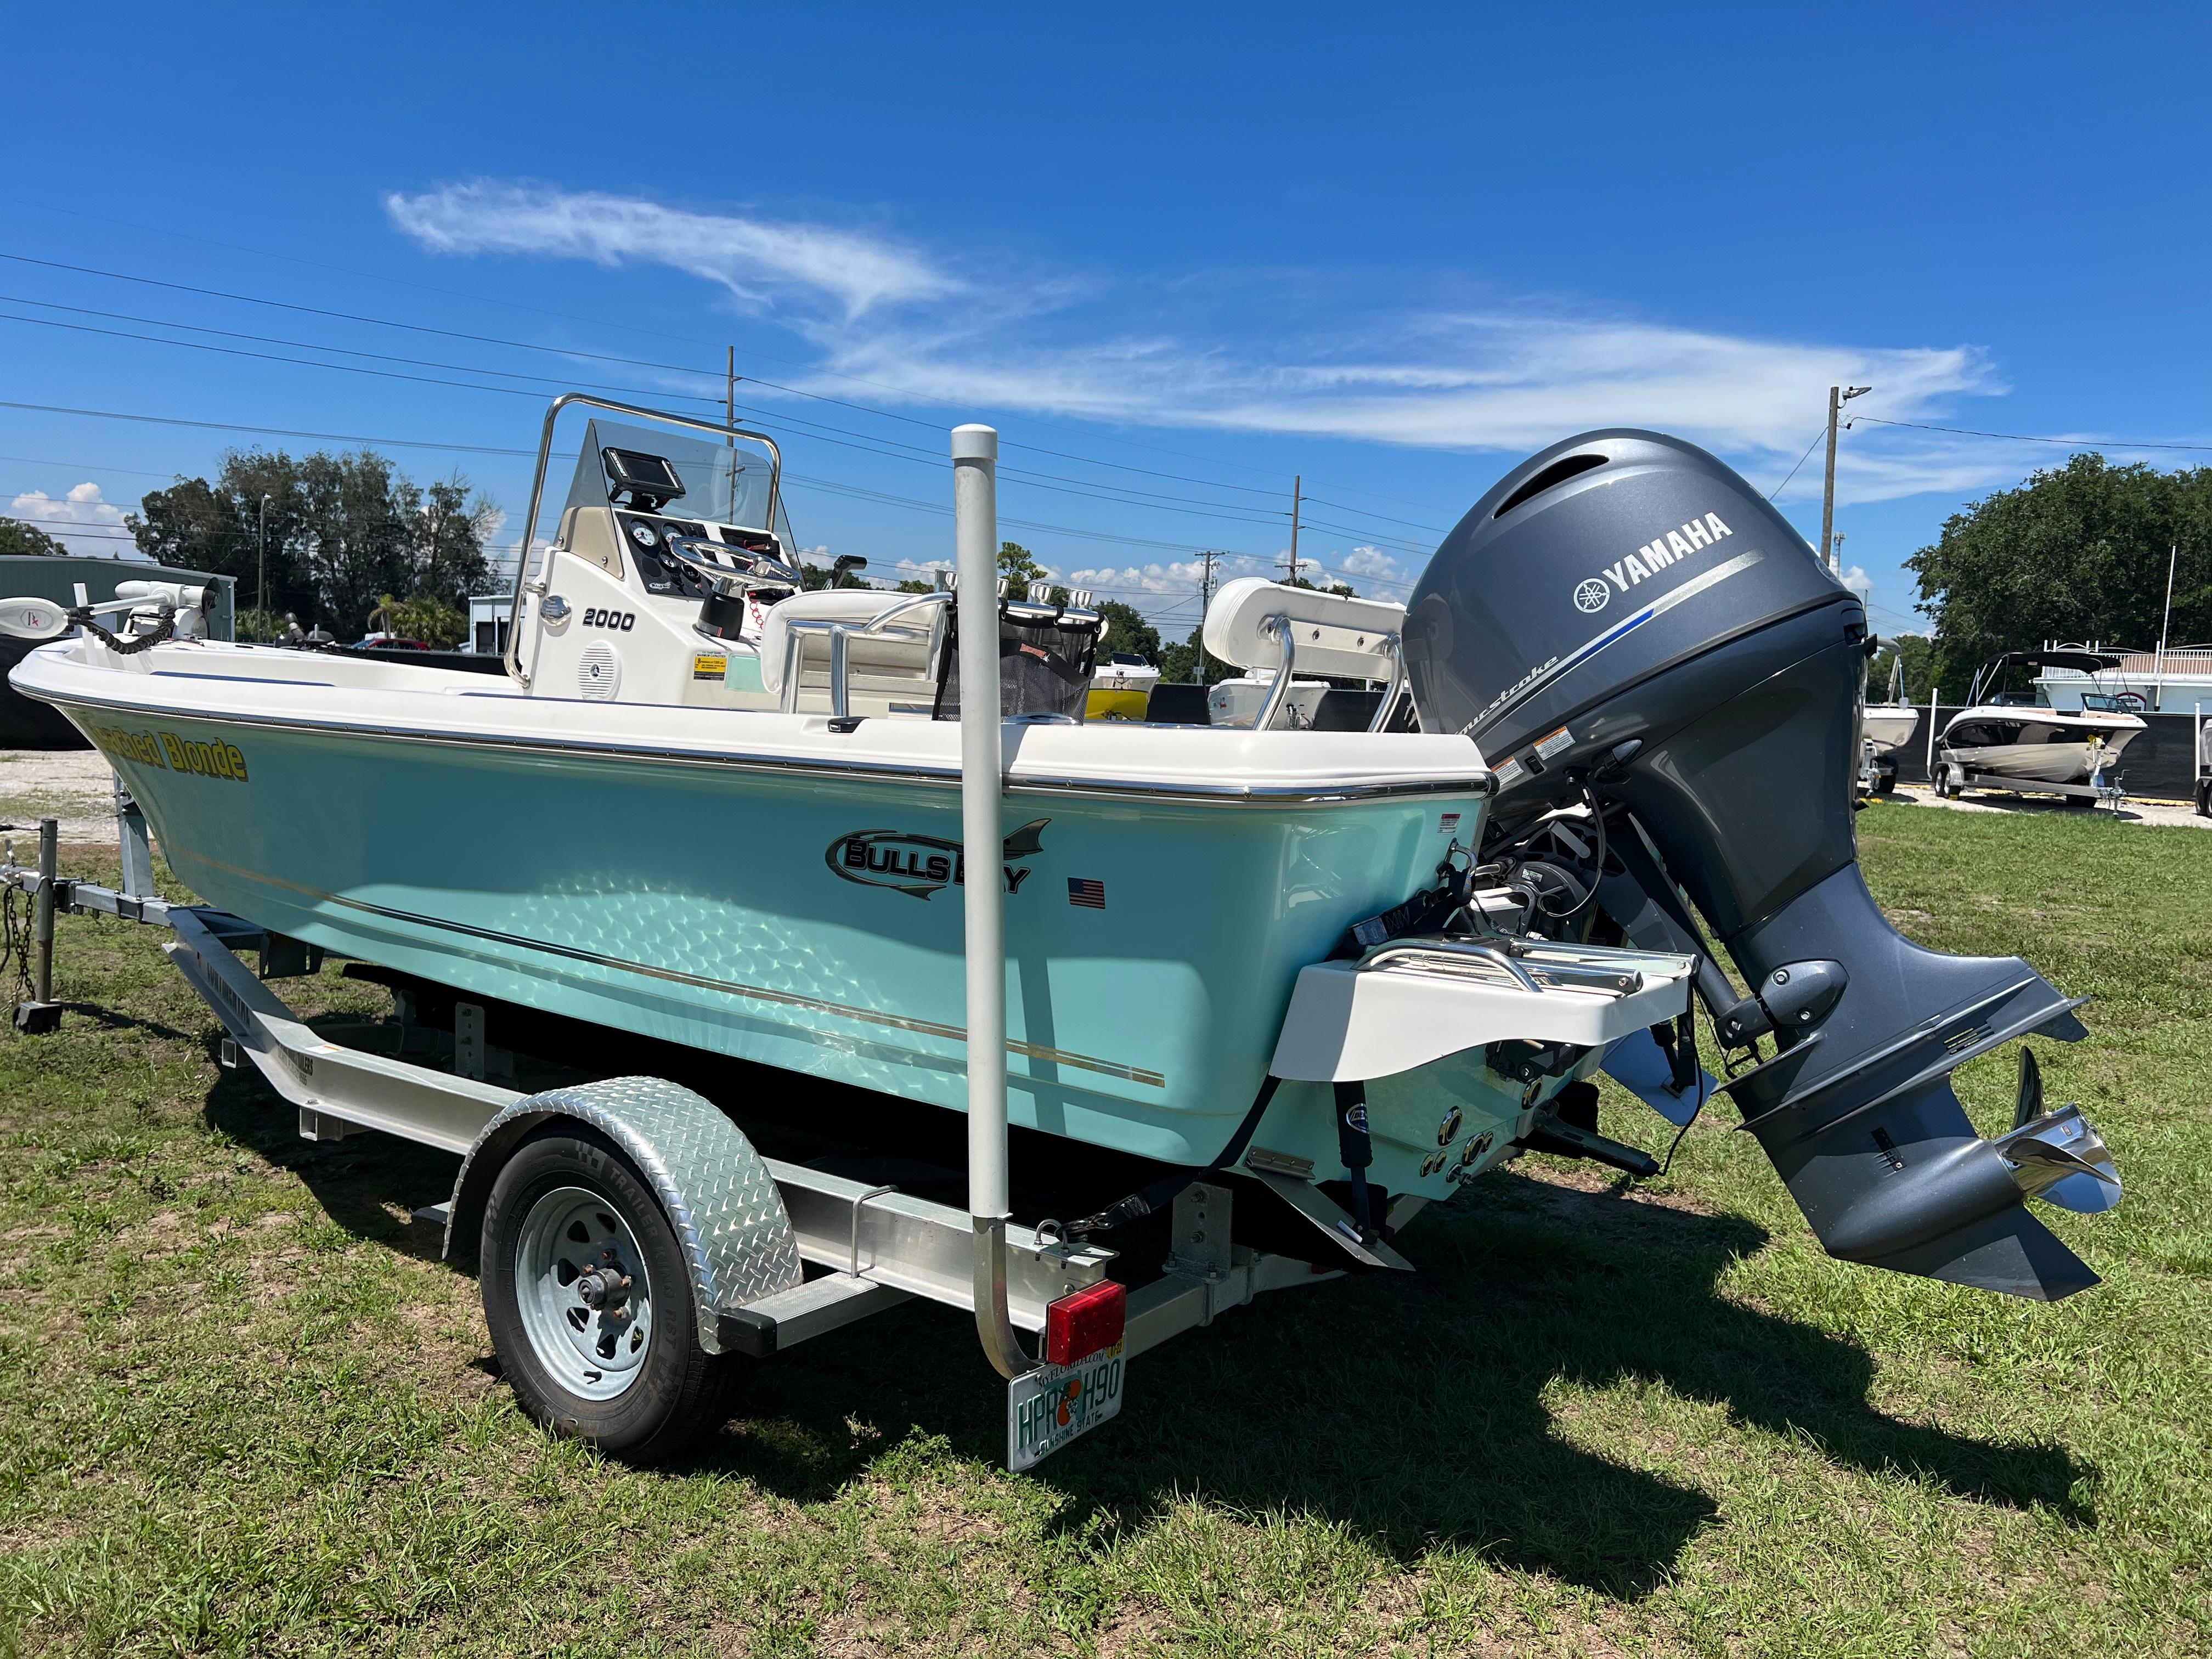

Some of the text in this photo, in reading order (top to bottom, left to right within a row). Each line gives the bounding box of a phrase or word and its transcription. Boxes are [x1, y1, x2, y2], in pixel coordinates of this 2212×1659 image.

[1601, 511, 1733, 592] YAMAHA
[582, 607, 636, 632] 2000
[157, 731, 249, 782] Blonde
[843, 837, 951, 883] BULLS
[610, 1167, 658, 1242] TRAILER
[1018, 1358, 1120, 1449] HPR H90
[1076, 1410, 1099, 1432] STATE
